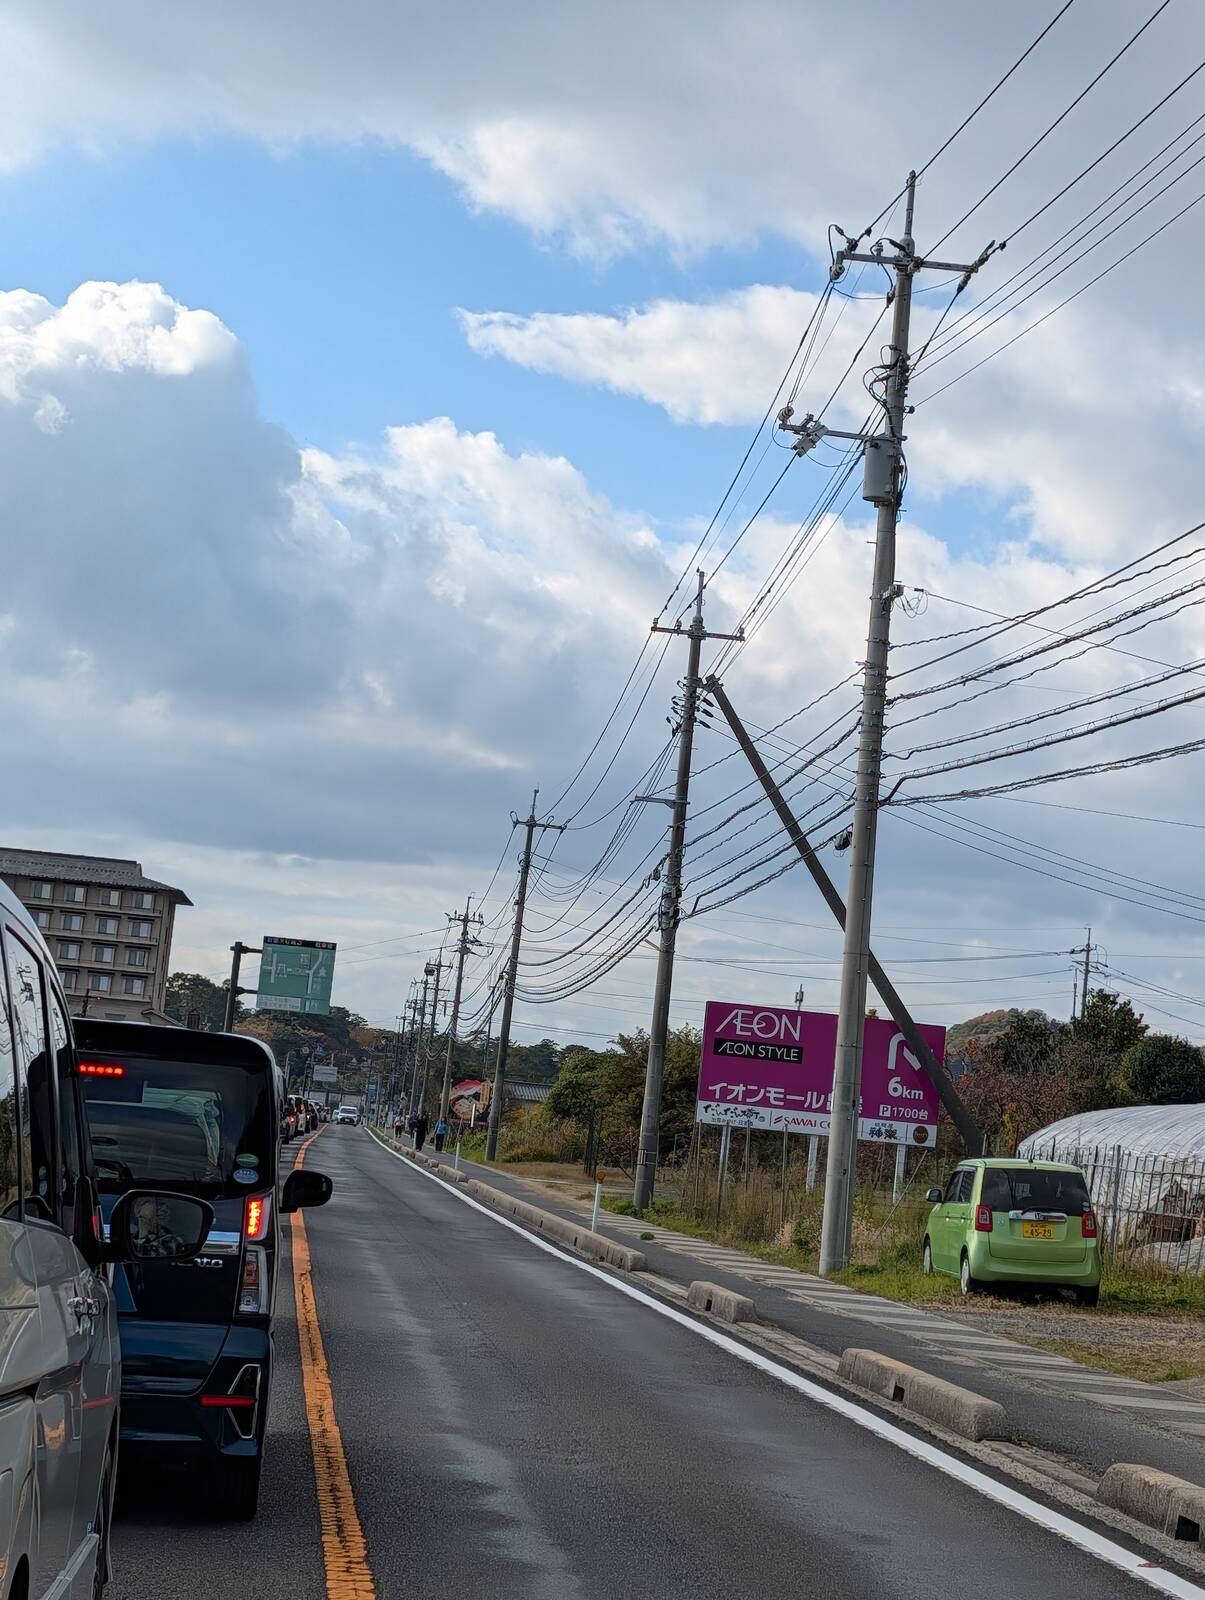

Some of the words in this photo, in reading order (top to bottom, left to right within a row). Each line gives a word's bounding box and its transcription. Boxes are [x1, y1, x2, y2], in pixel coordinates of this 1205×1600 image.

[758, 1045, 799, 1061] STYLE
[887, 1076, 924, 1100] 6km
[708, 1082, 863, 1114] イオンモール
[893, 1107, 928, 1120] 1700台
[785, 1116, 817, 1128] SAWAI
